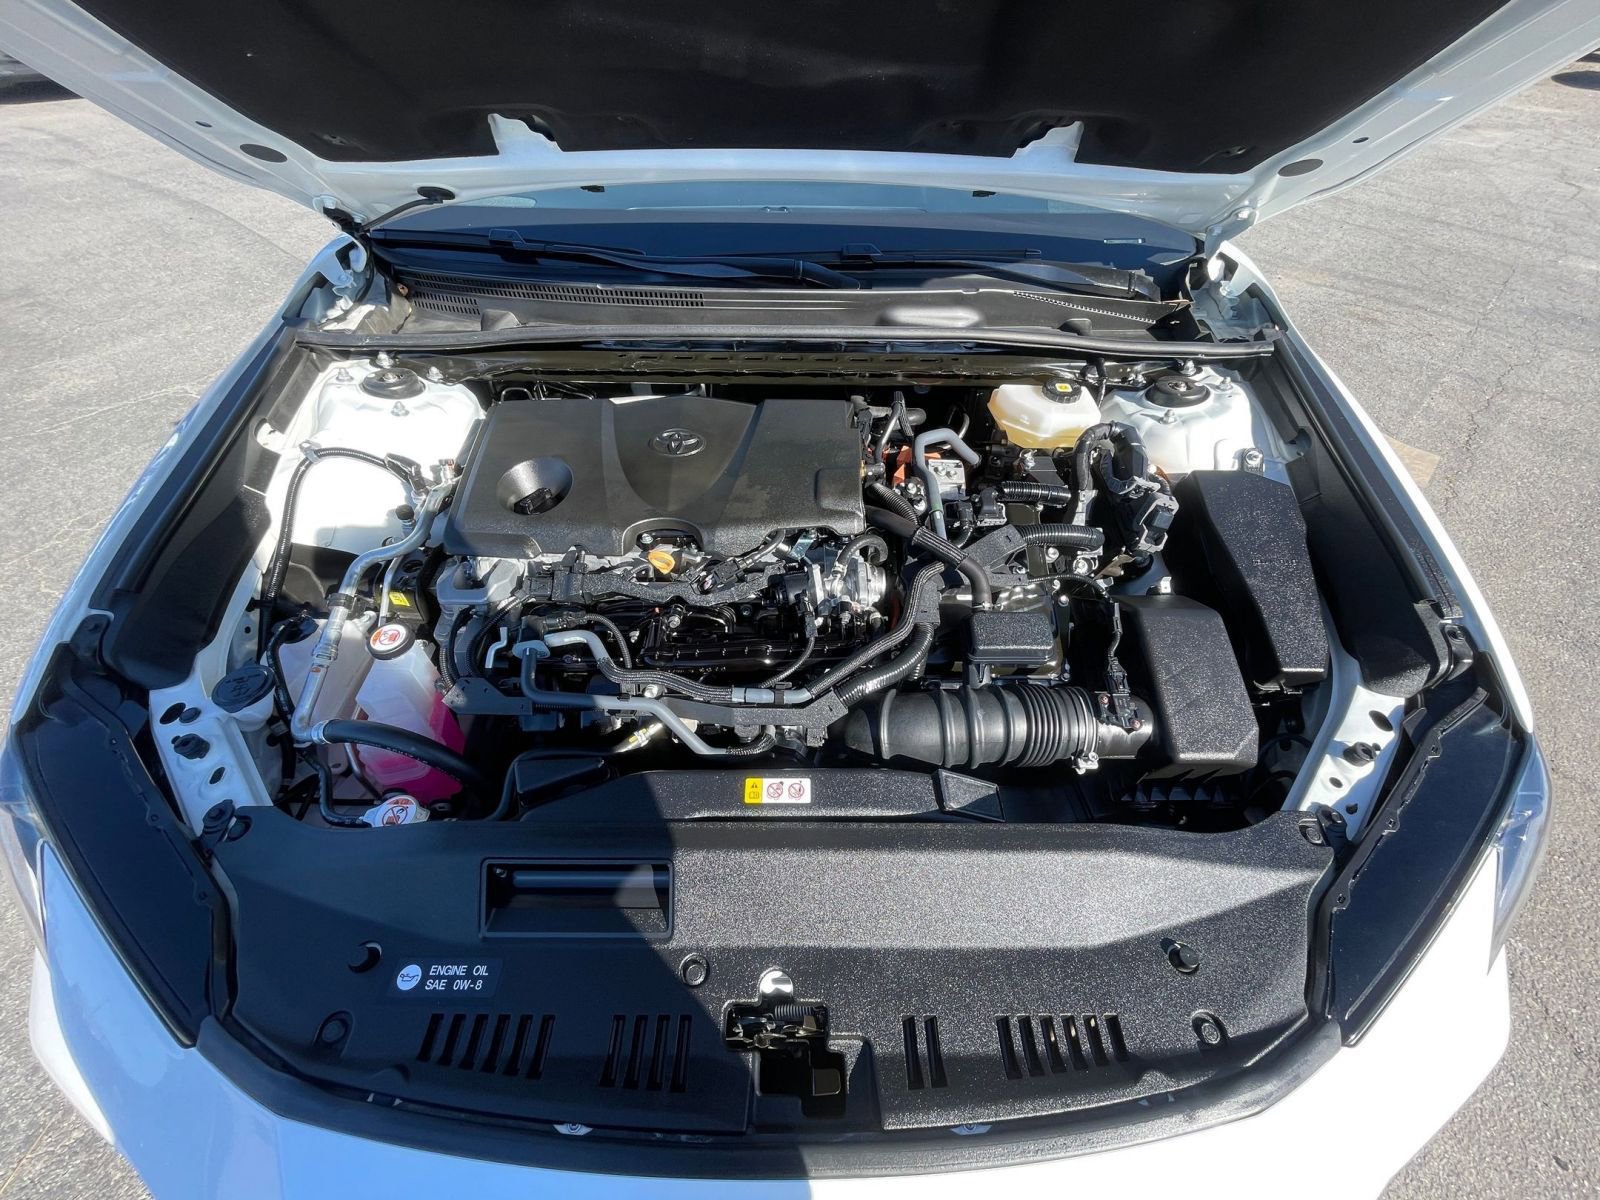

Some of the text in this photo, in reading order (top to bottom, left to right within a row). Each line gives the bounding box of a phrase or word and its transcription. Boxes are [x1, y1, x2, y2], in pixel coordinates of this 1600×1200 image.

[429, 965, 489, 976] ENGINE OIL
[424, 979, 483, 990] SAE 0W-8
